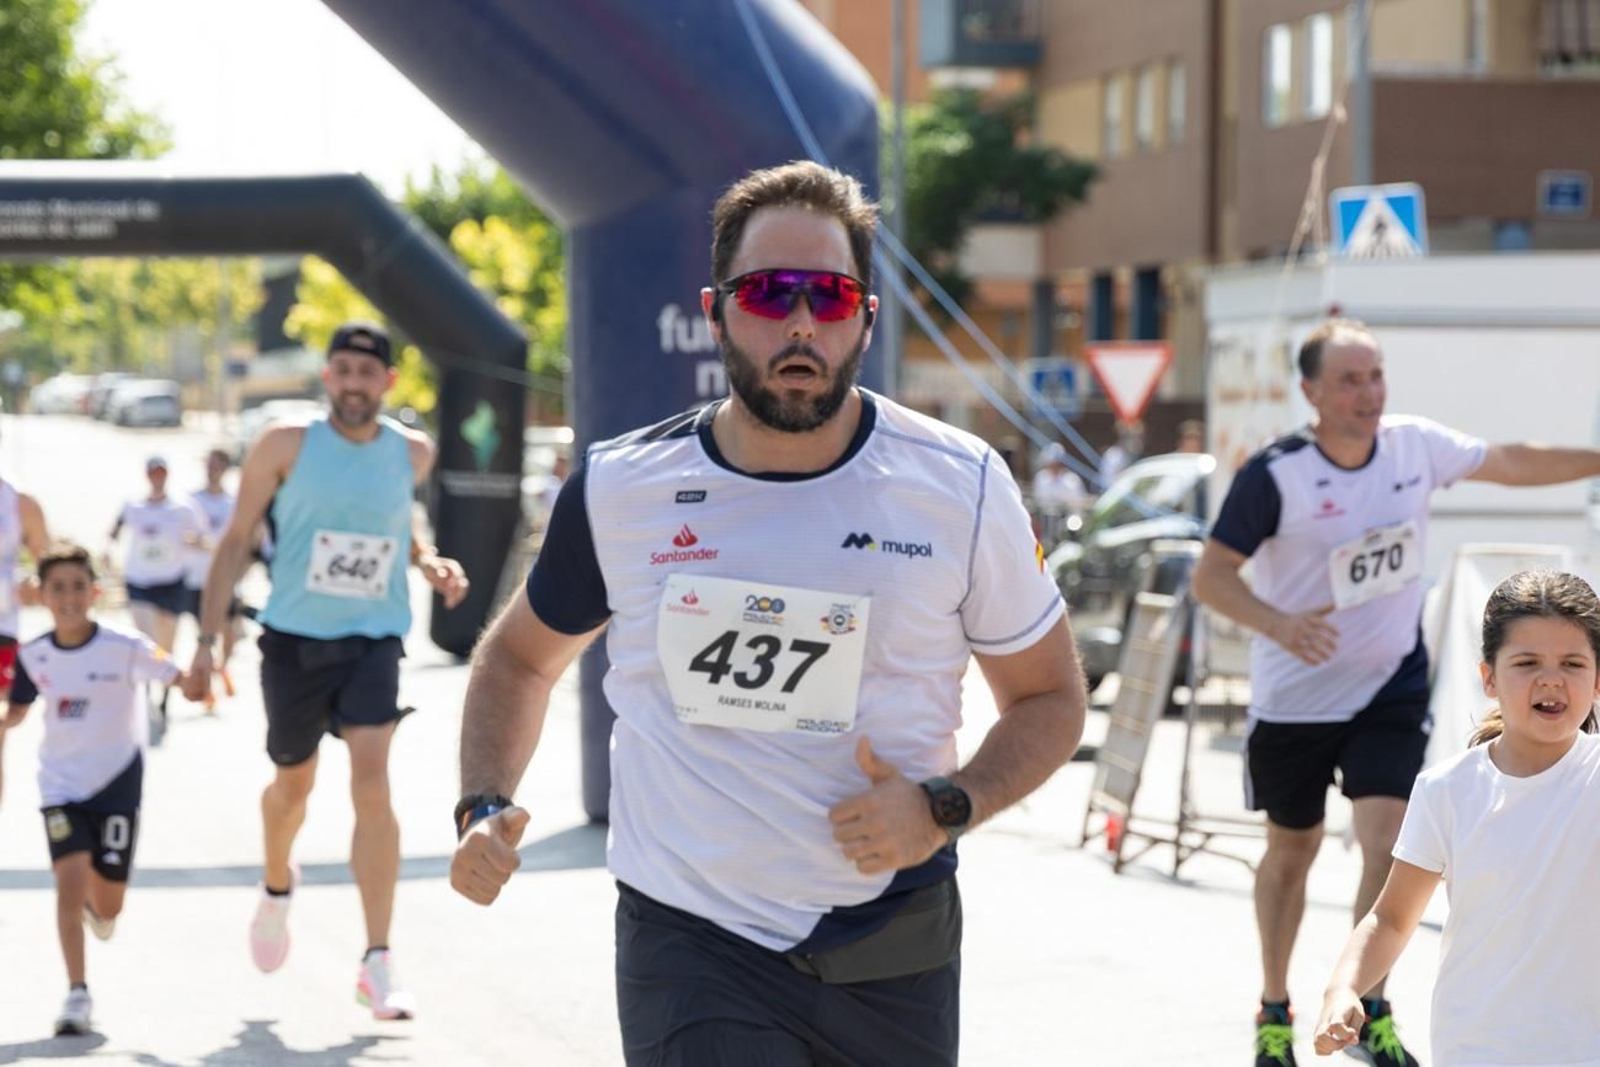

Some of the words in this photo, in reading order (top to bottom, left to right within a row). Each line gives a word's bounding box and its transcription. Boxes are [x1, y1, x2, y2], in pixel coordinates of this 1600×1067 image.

[650, 548, 719, 565] Santander
[882, 538, 932, 558] mupol
[327, 553, 379, 580] 640
[1350, 542, 1403, 584] 670
[688, 629, 831, 694] 437
[718, 695, 752, 709] RAMSES
[754, 699, 786, 712] MOLINA
